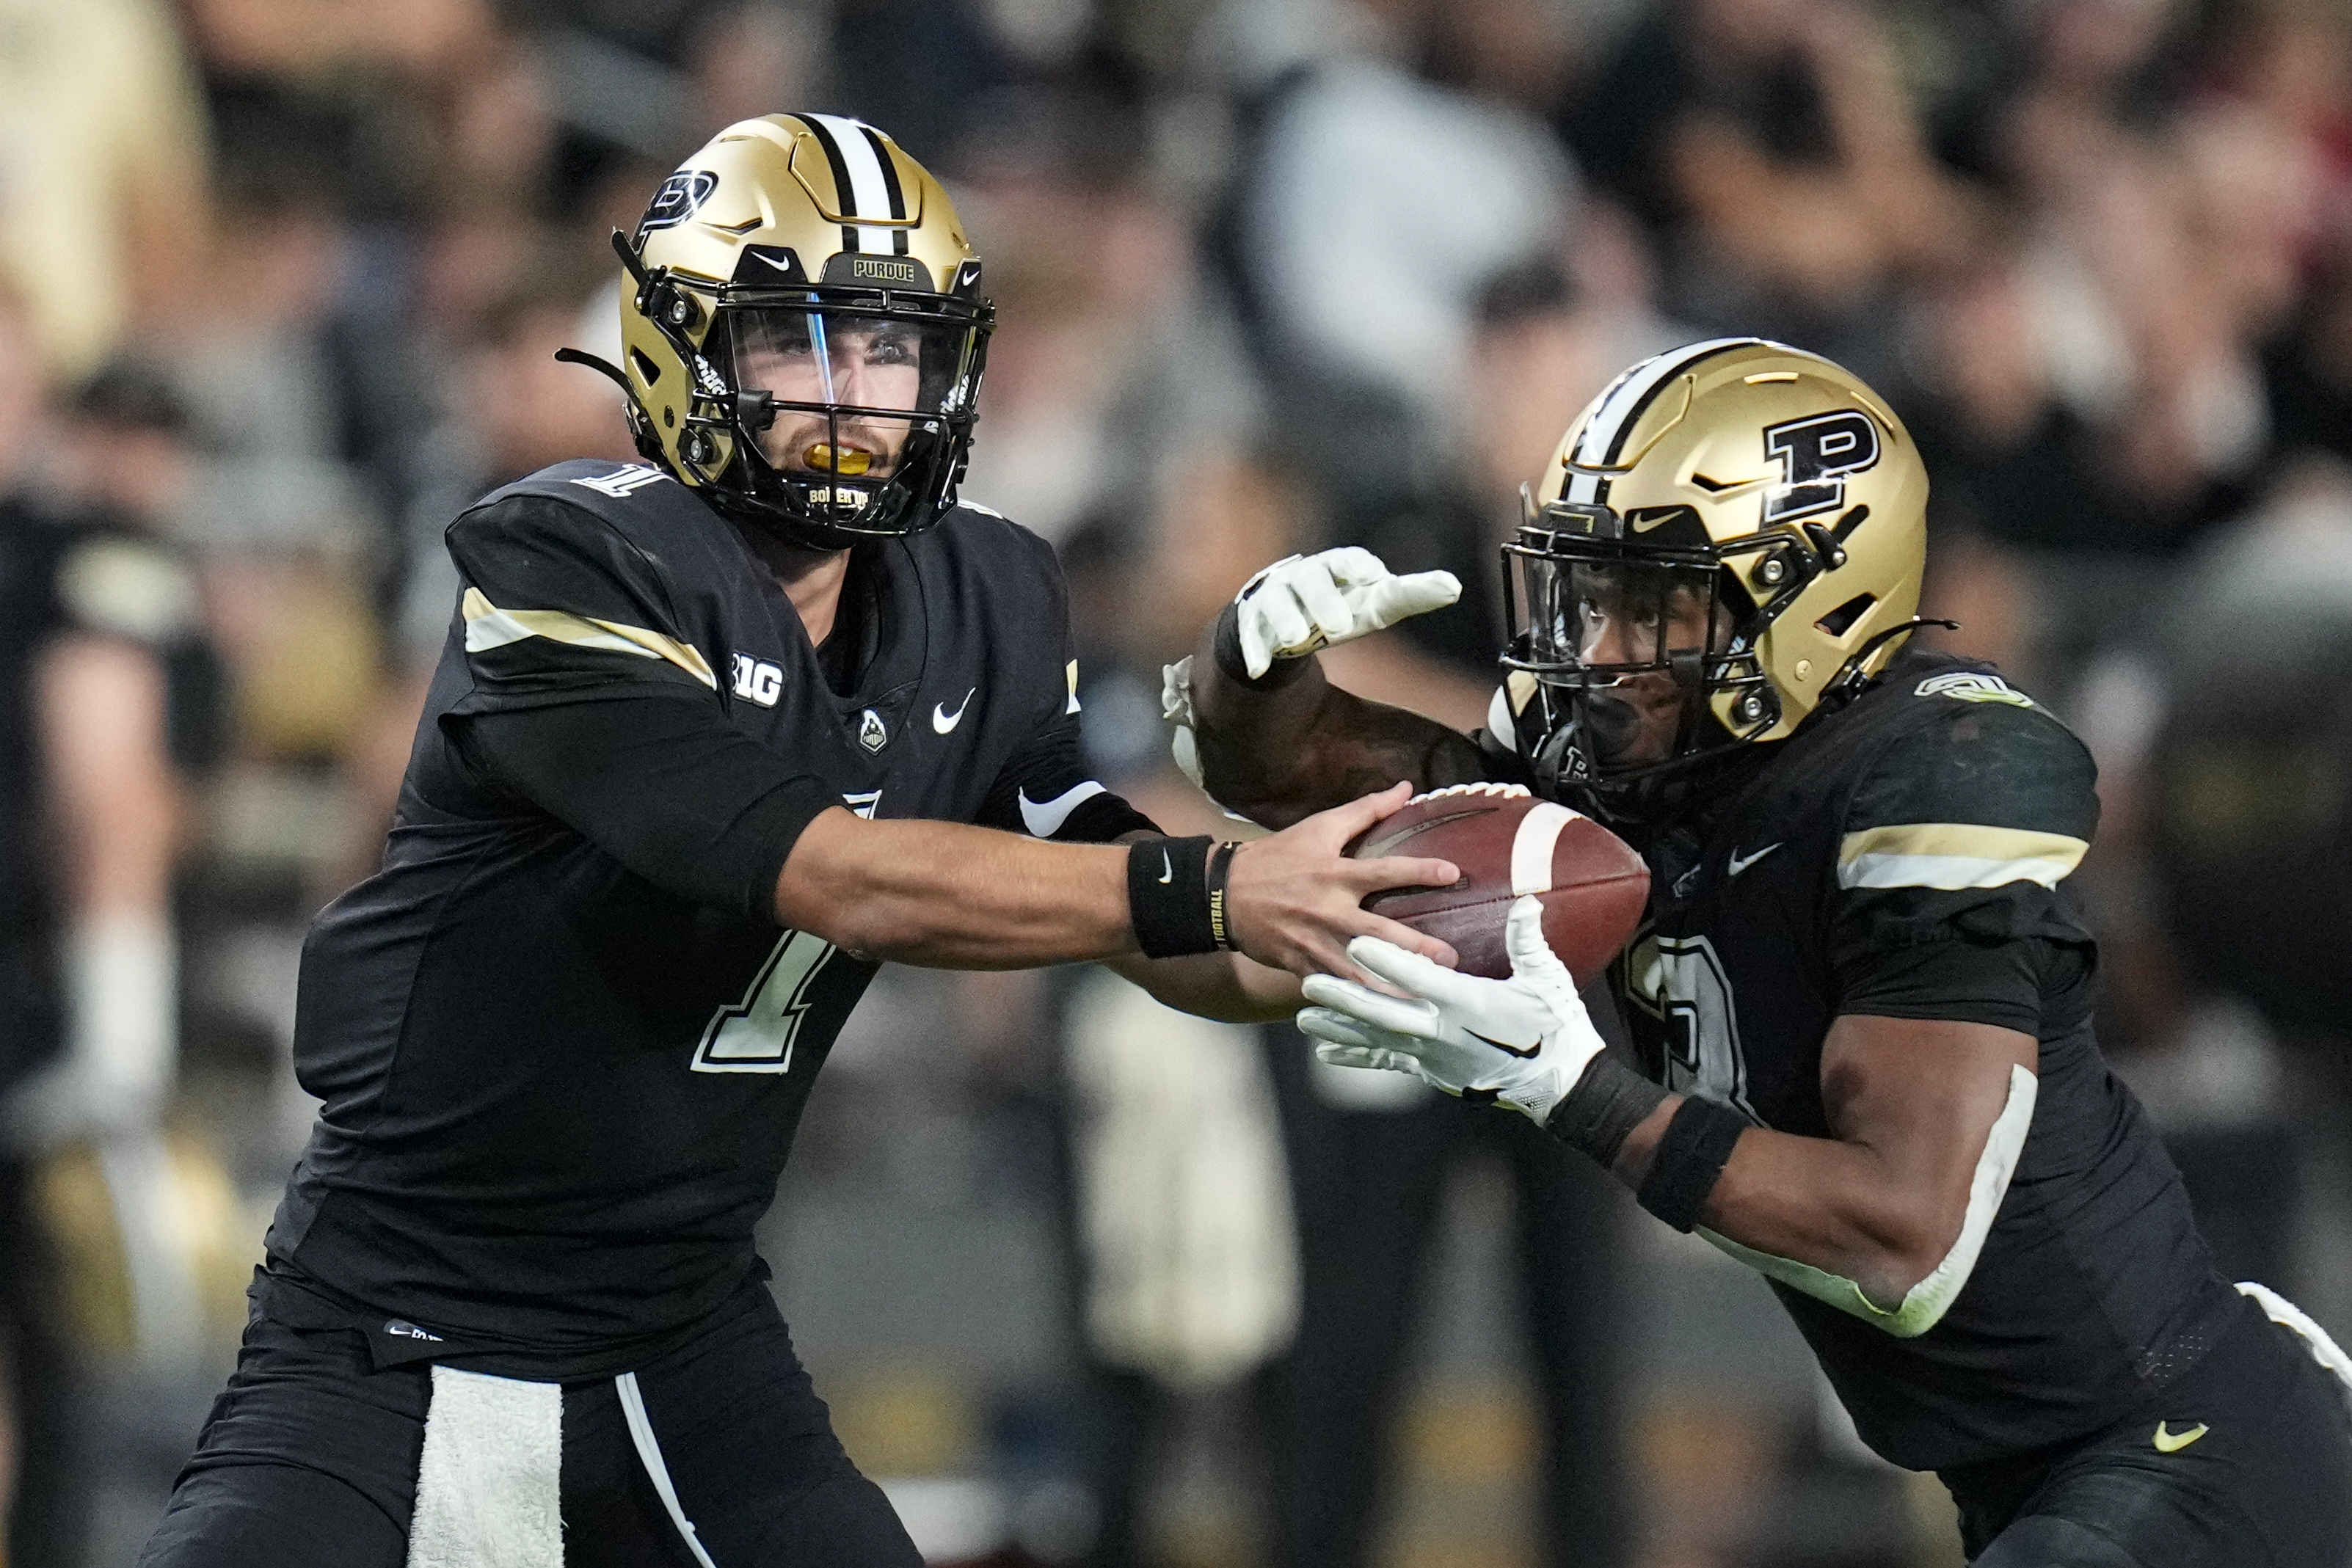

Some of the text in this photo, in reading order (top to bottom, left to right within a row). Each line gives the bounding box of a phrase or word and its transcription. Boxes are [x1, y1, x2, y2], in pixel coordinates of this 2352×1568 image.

[633, 170, 719, 257] P
[853, 259, 915, 282] PURDUE
[809, 486, 869, 506] BOIER UP
[1760, 408, 1882, 530] P
[732, 652, 783, 706] 1G
[690, 789, 883, 1073] 1
[1211, 889, 1226, 941] FOOTBALL
